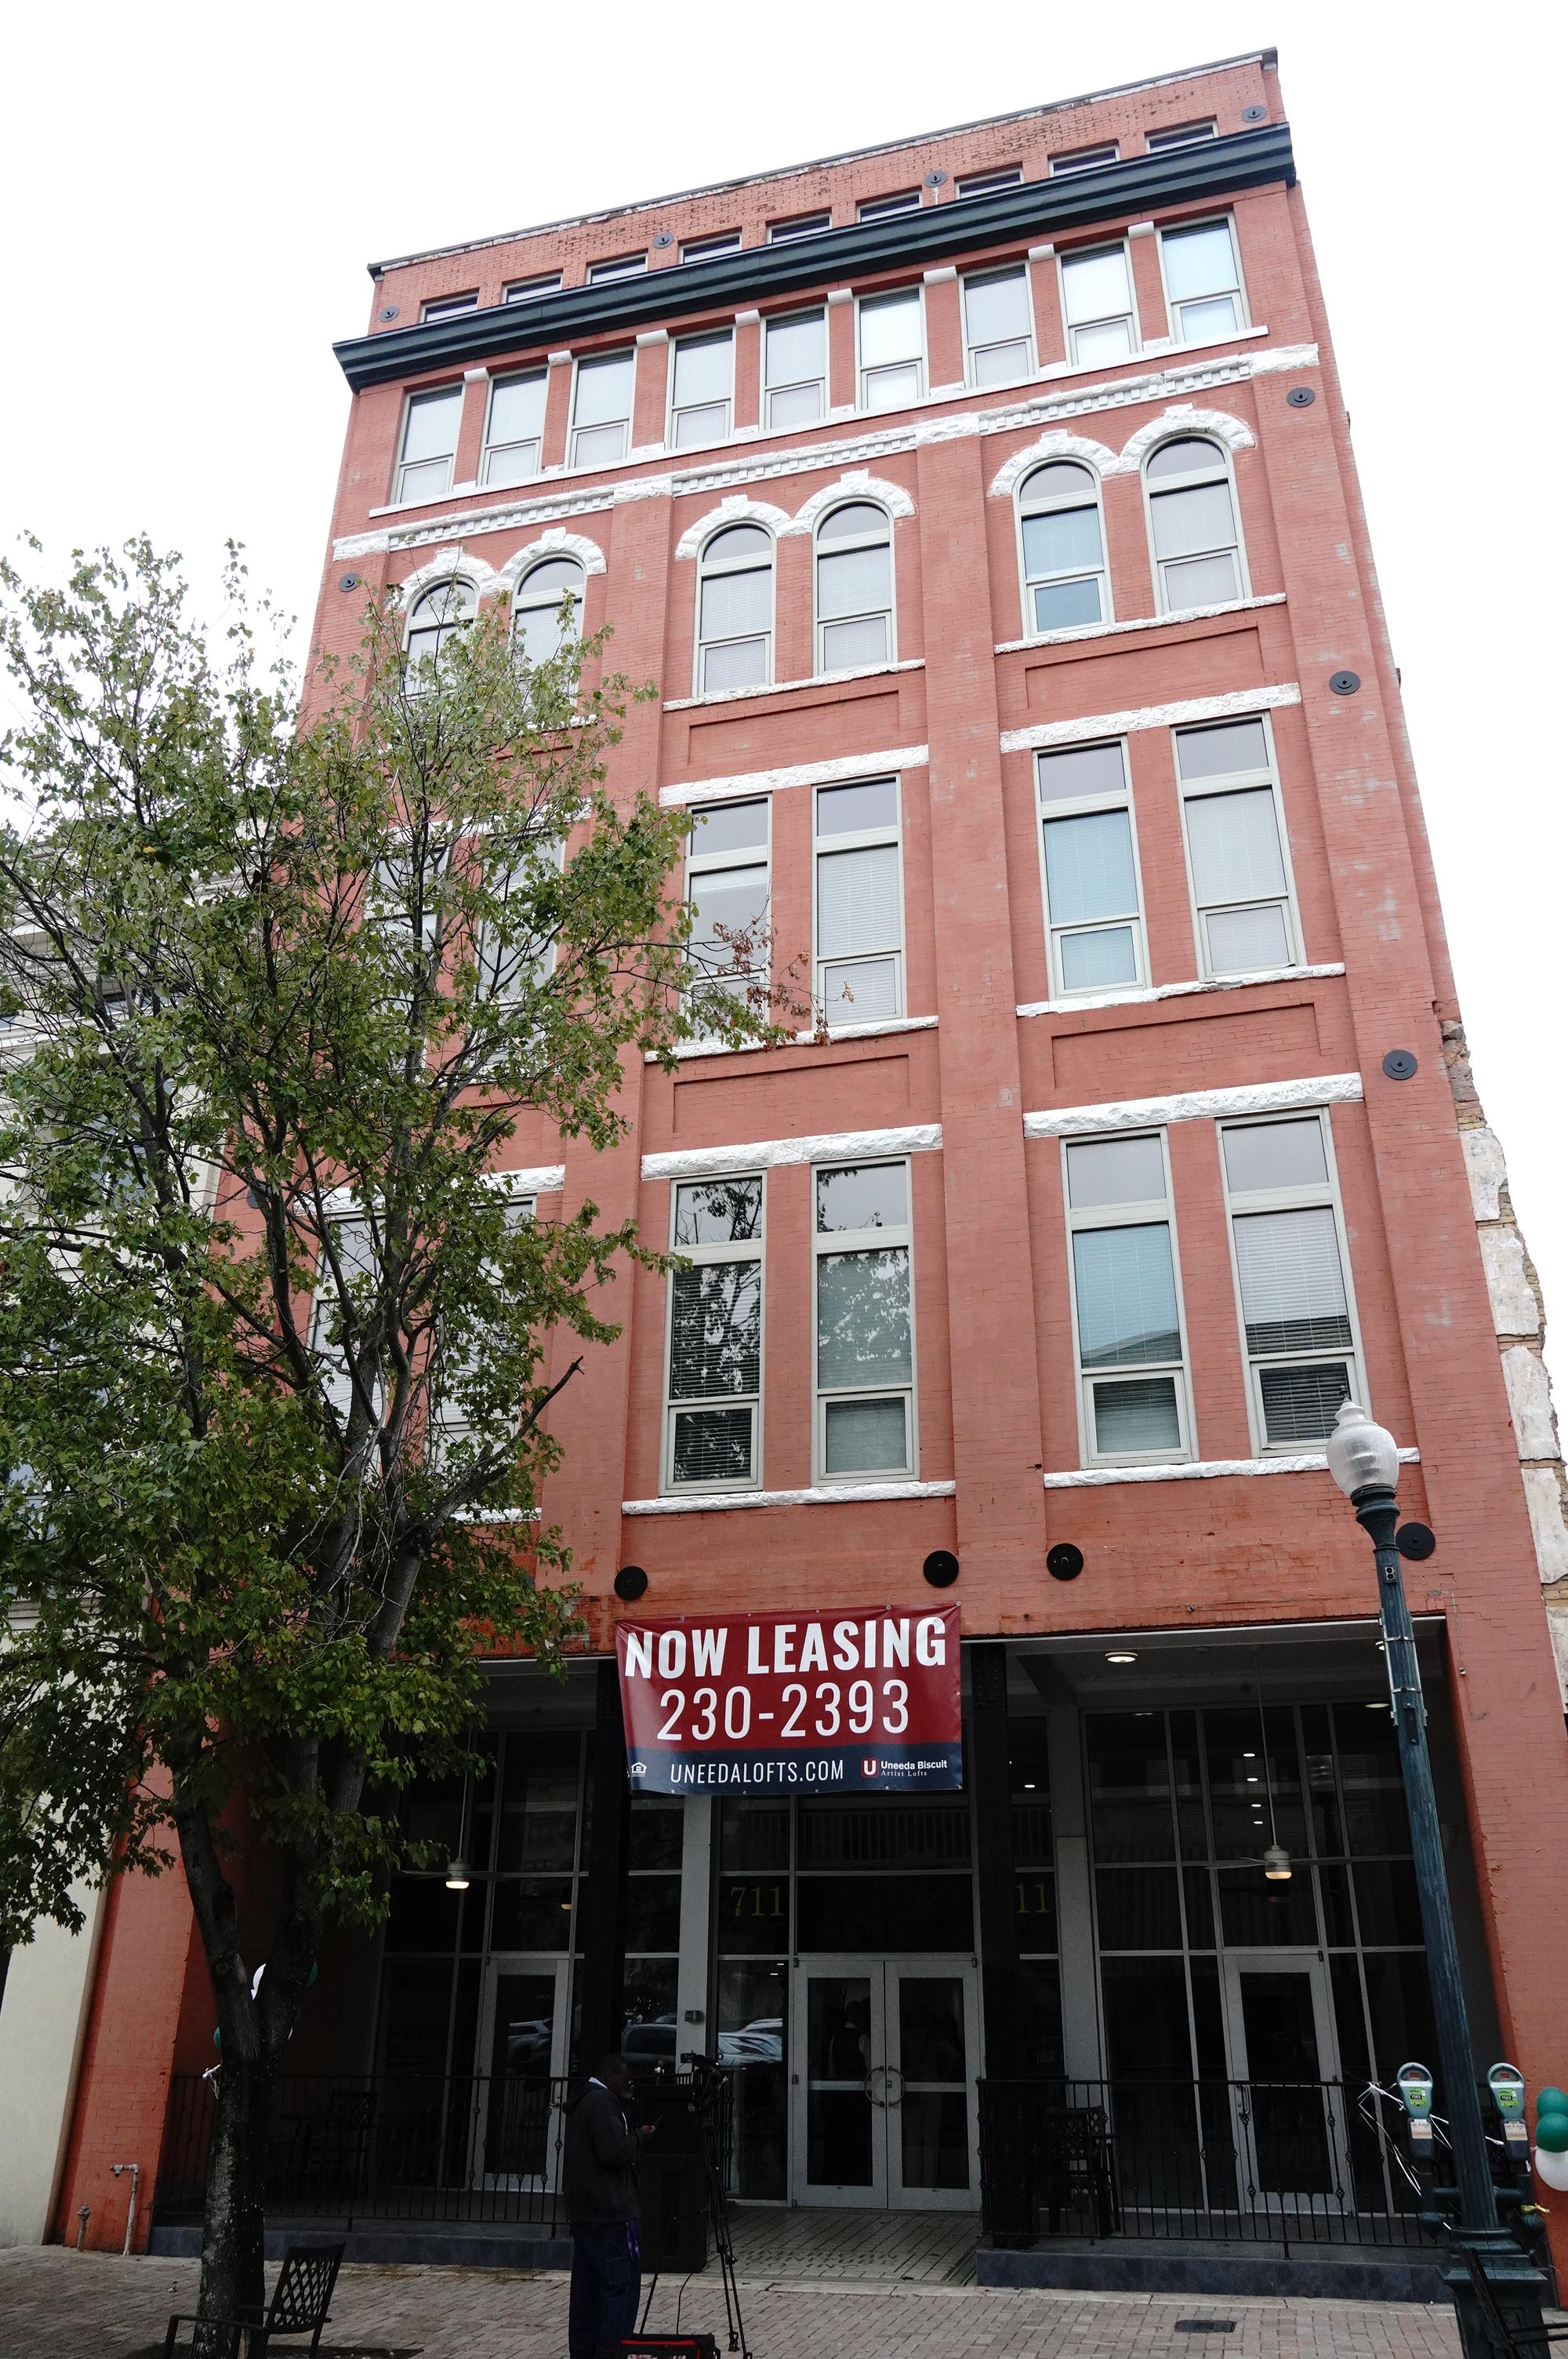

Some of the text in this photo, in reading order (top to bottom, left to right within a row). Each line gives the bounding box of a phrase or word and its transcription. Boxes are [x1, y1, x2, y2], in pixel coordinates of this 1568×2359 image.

[625, 1616, 946, 1679] NOW LEASING
[657, 1679, 909, 1740] 230-2393
[670, 1759, 844, 1783] UNEEDALOFTS.COM
[880, 1760, 947, 1769] Uneeda Biscuit
[731, 1885, 783, 1917] 711
[1015, 1882, 1051, 1913] 11
